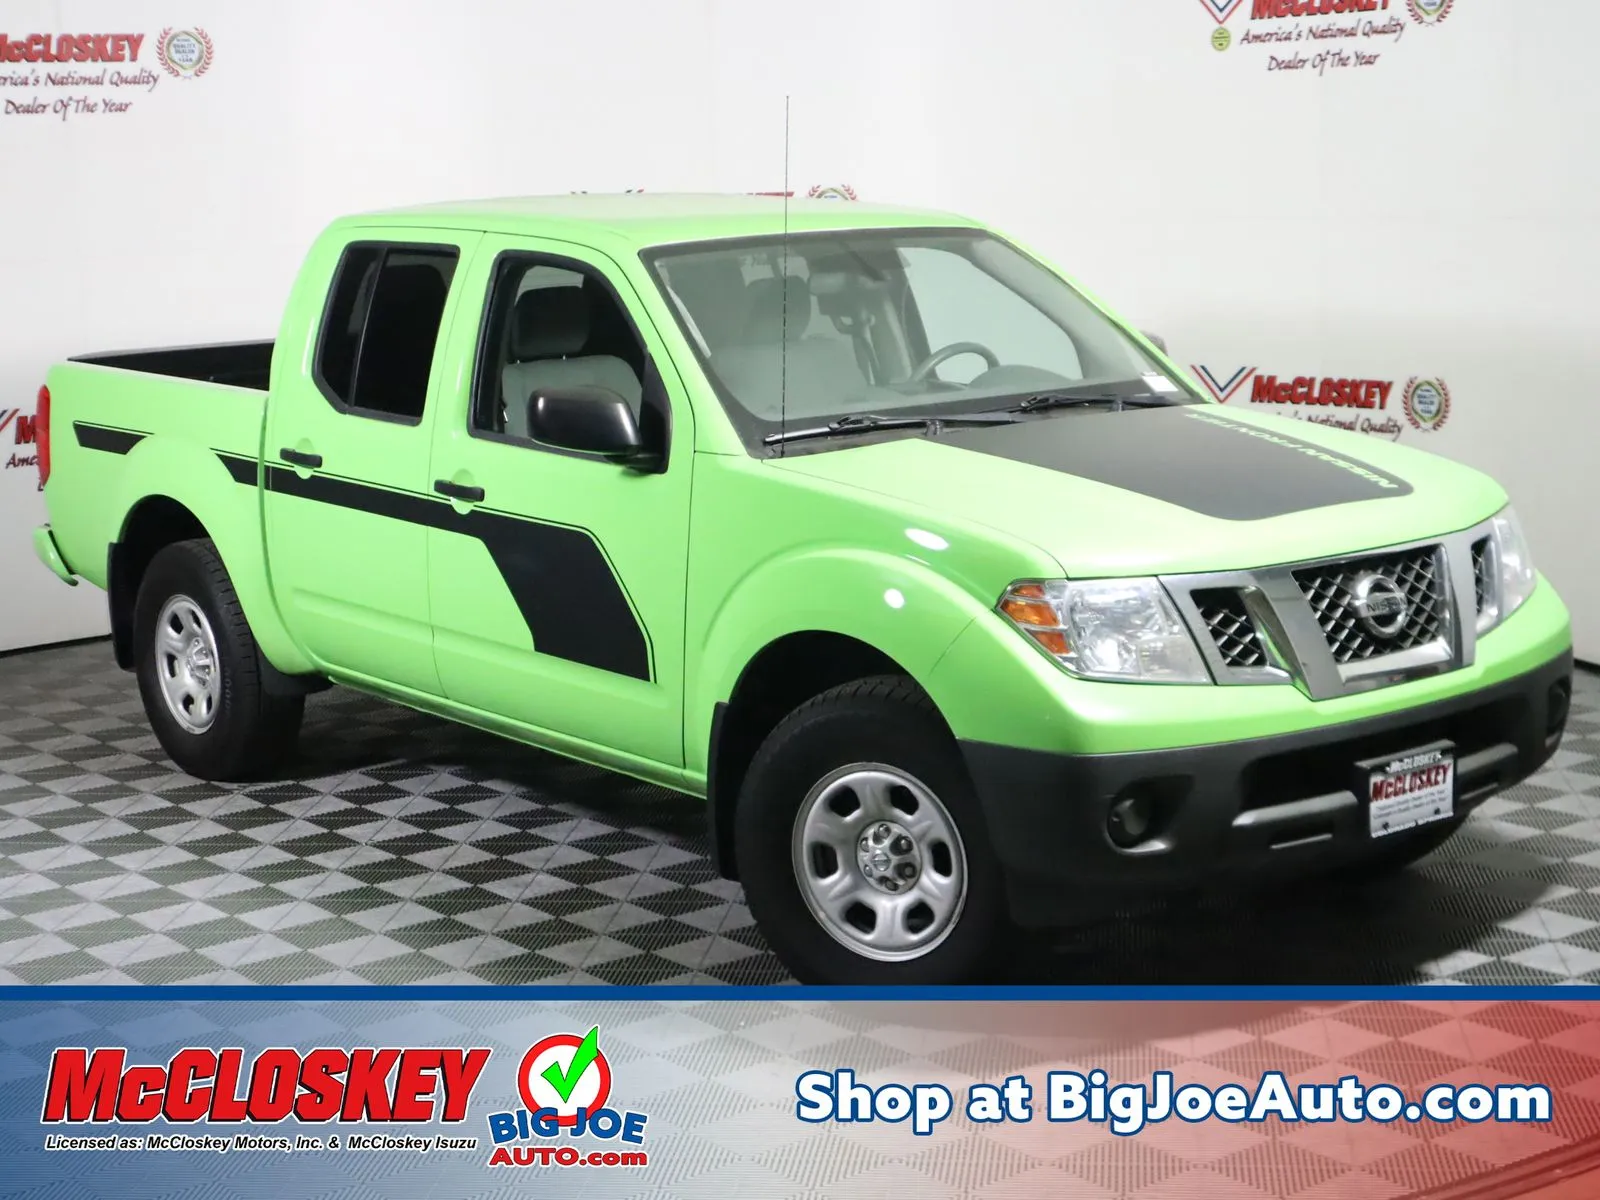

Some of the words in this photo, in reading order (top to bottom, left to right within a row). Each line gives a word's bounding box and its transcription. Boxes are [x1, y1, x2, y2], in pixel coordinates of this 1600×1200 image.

[1240, 23, 1303, 45] America's
[1306, 19, 1360, 40] National
[1362, 16, 1406, 43] Quality
[0, 33, 145, 63] cCLOSKEY
[1267, 50, 1308, 71] Dealer
[1311, 49, 1332, 76] Of
[1330, 48, 1350, 67] The
[1353, 48, 1381, 66] Year
[44, 69, 105, 86] National
[109, 69, 160, 92] Quality
[4, 97, 49, 115] Dealer
[52, 95, 73, 121] Of
[74, 97, 97, 114] The
[101, 98, 133, 114] Year
[1250, 375, 1393, 409] McCLOSKEY
[1359, 416, 1404, 442] Quality
